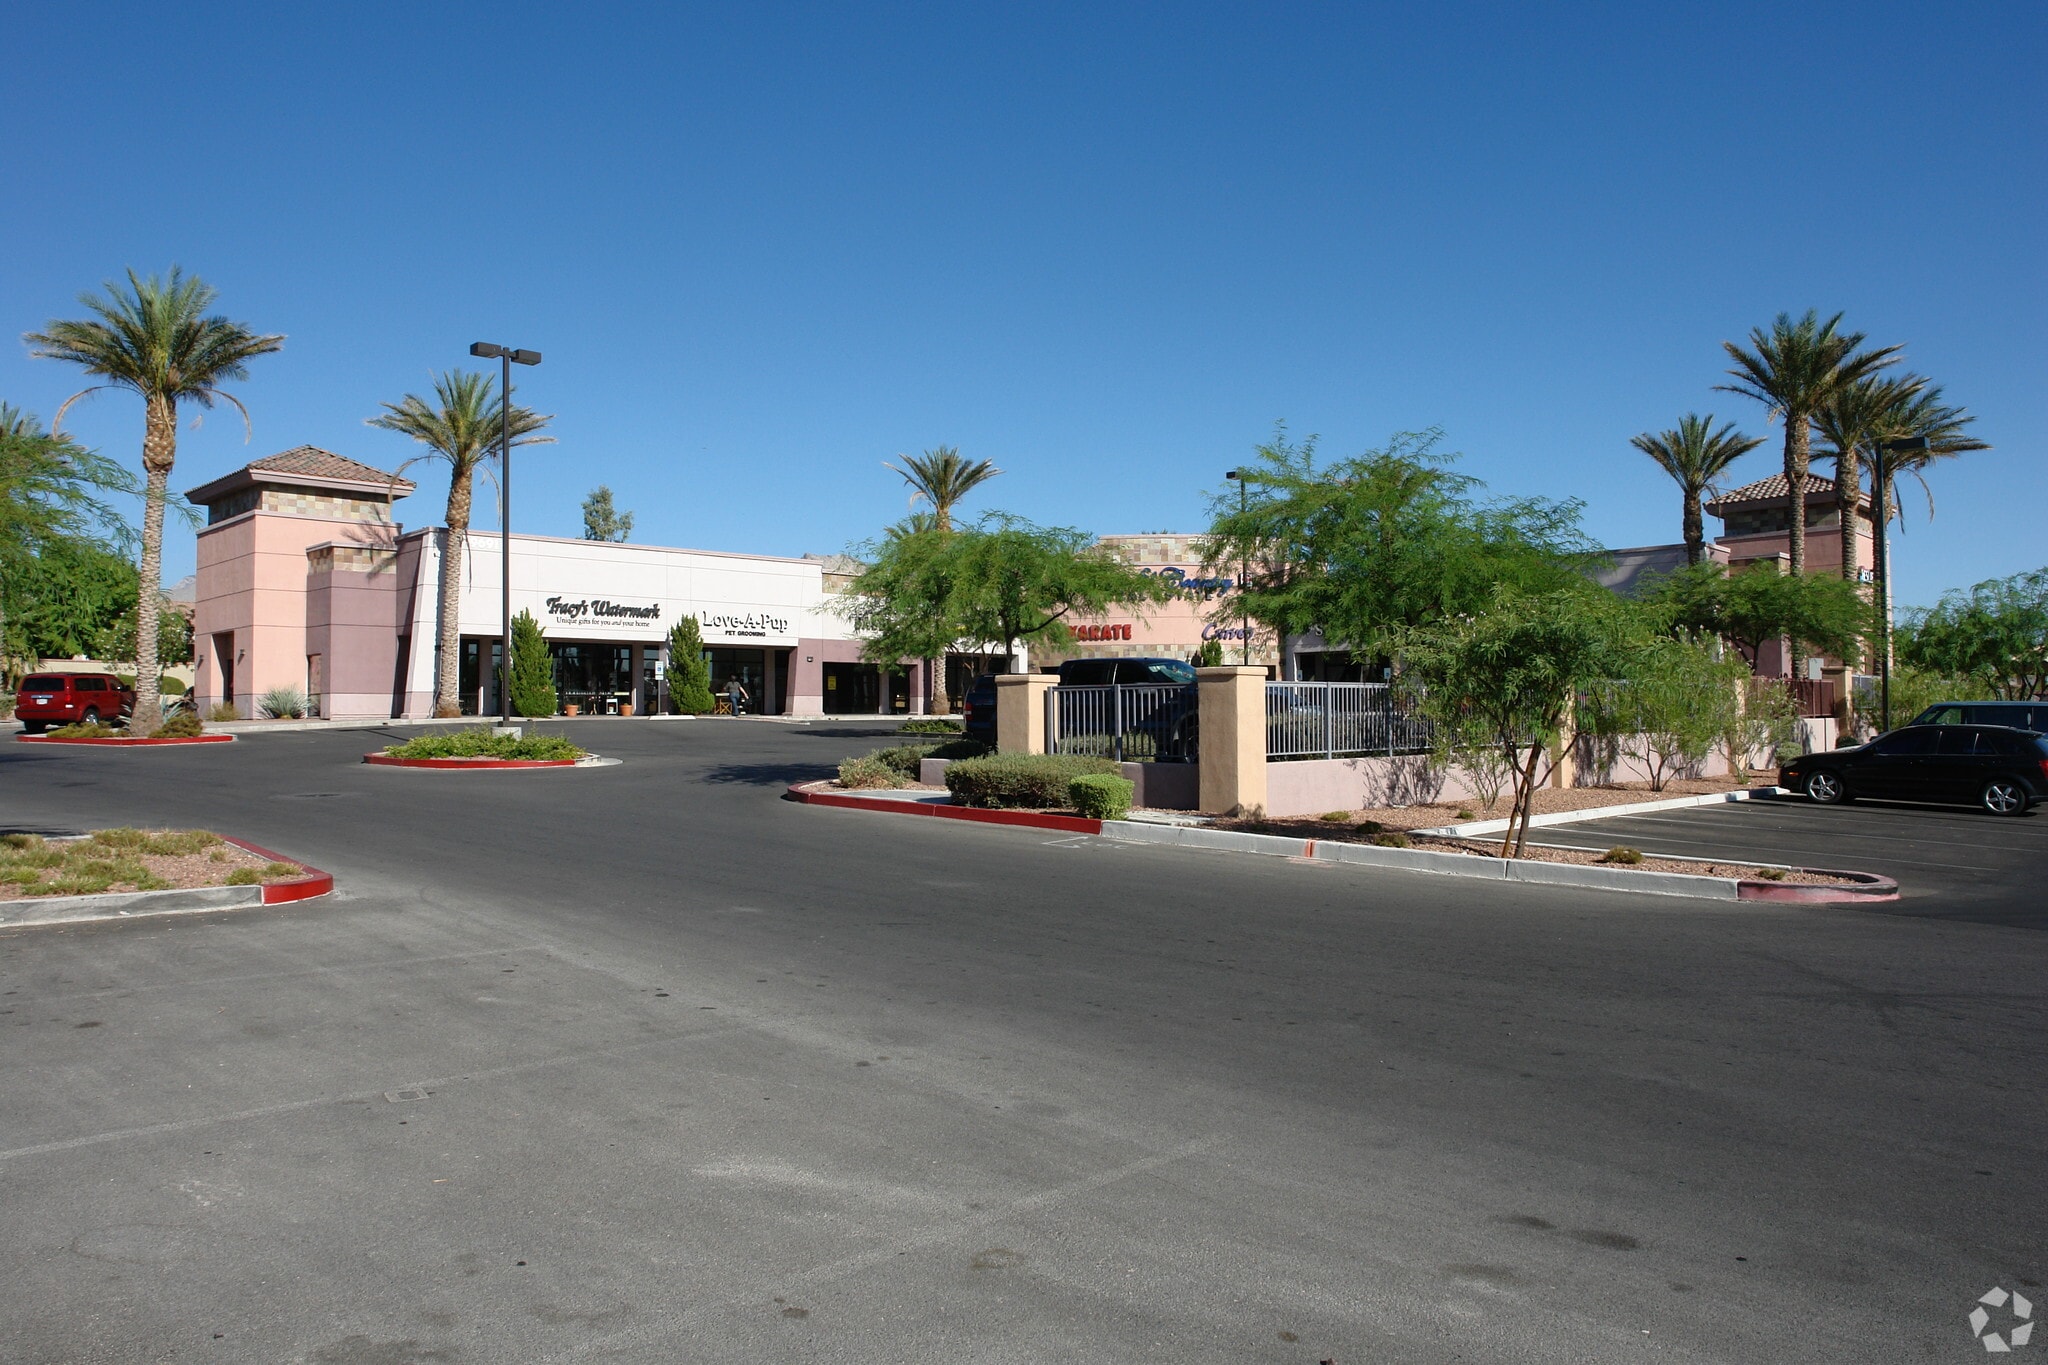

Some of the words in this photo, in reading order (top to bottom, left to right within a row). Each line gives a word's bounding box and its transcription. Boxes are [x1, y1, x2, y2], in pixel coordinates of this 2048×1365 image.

[546, 596, 588, 618] Tracy's
[590, 600, 661, 619] Watermark
[556, 616, 577, 625] Unique
[578, 617, 591, 625] gifts
[600, 619, 611, 627] you
[611, 618, 622, 626] and
[622, 620, 634, 628] your
[703, 610, 788, 633] Love-A-Pup
